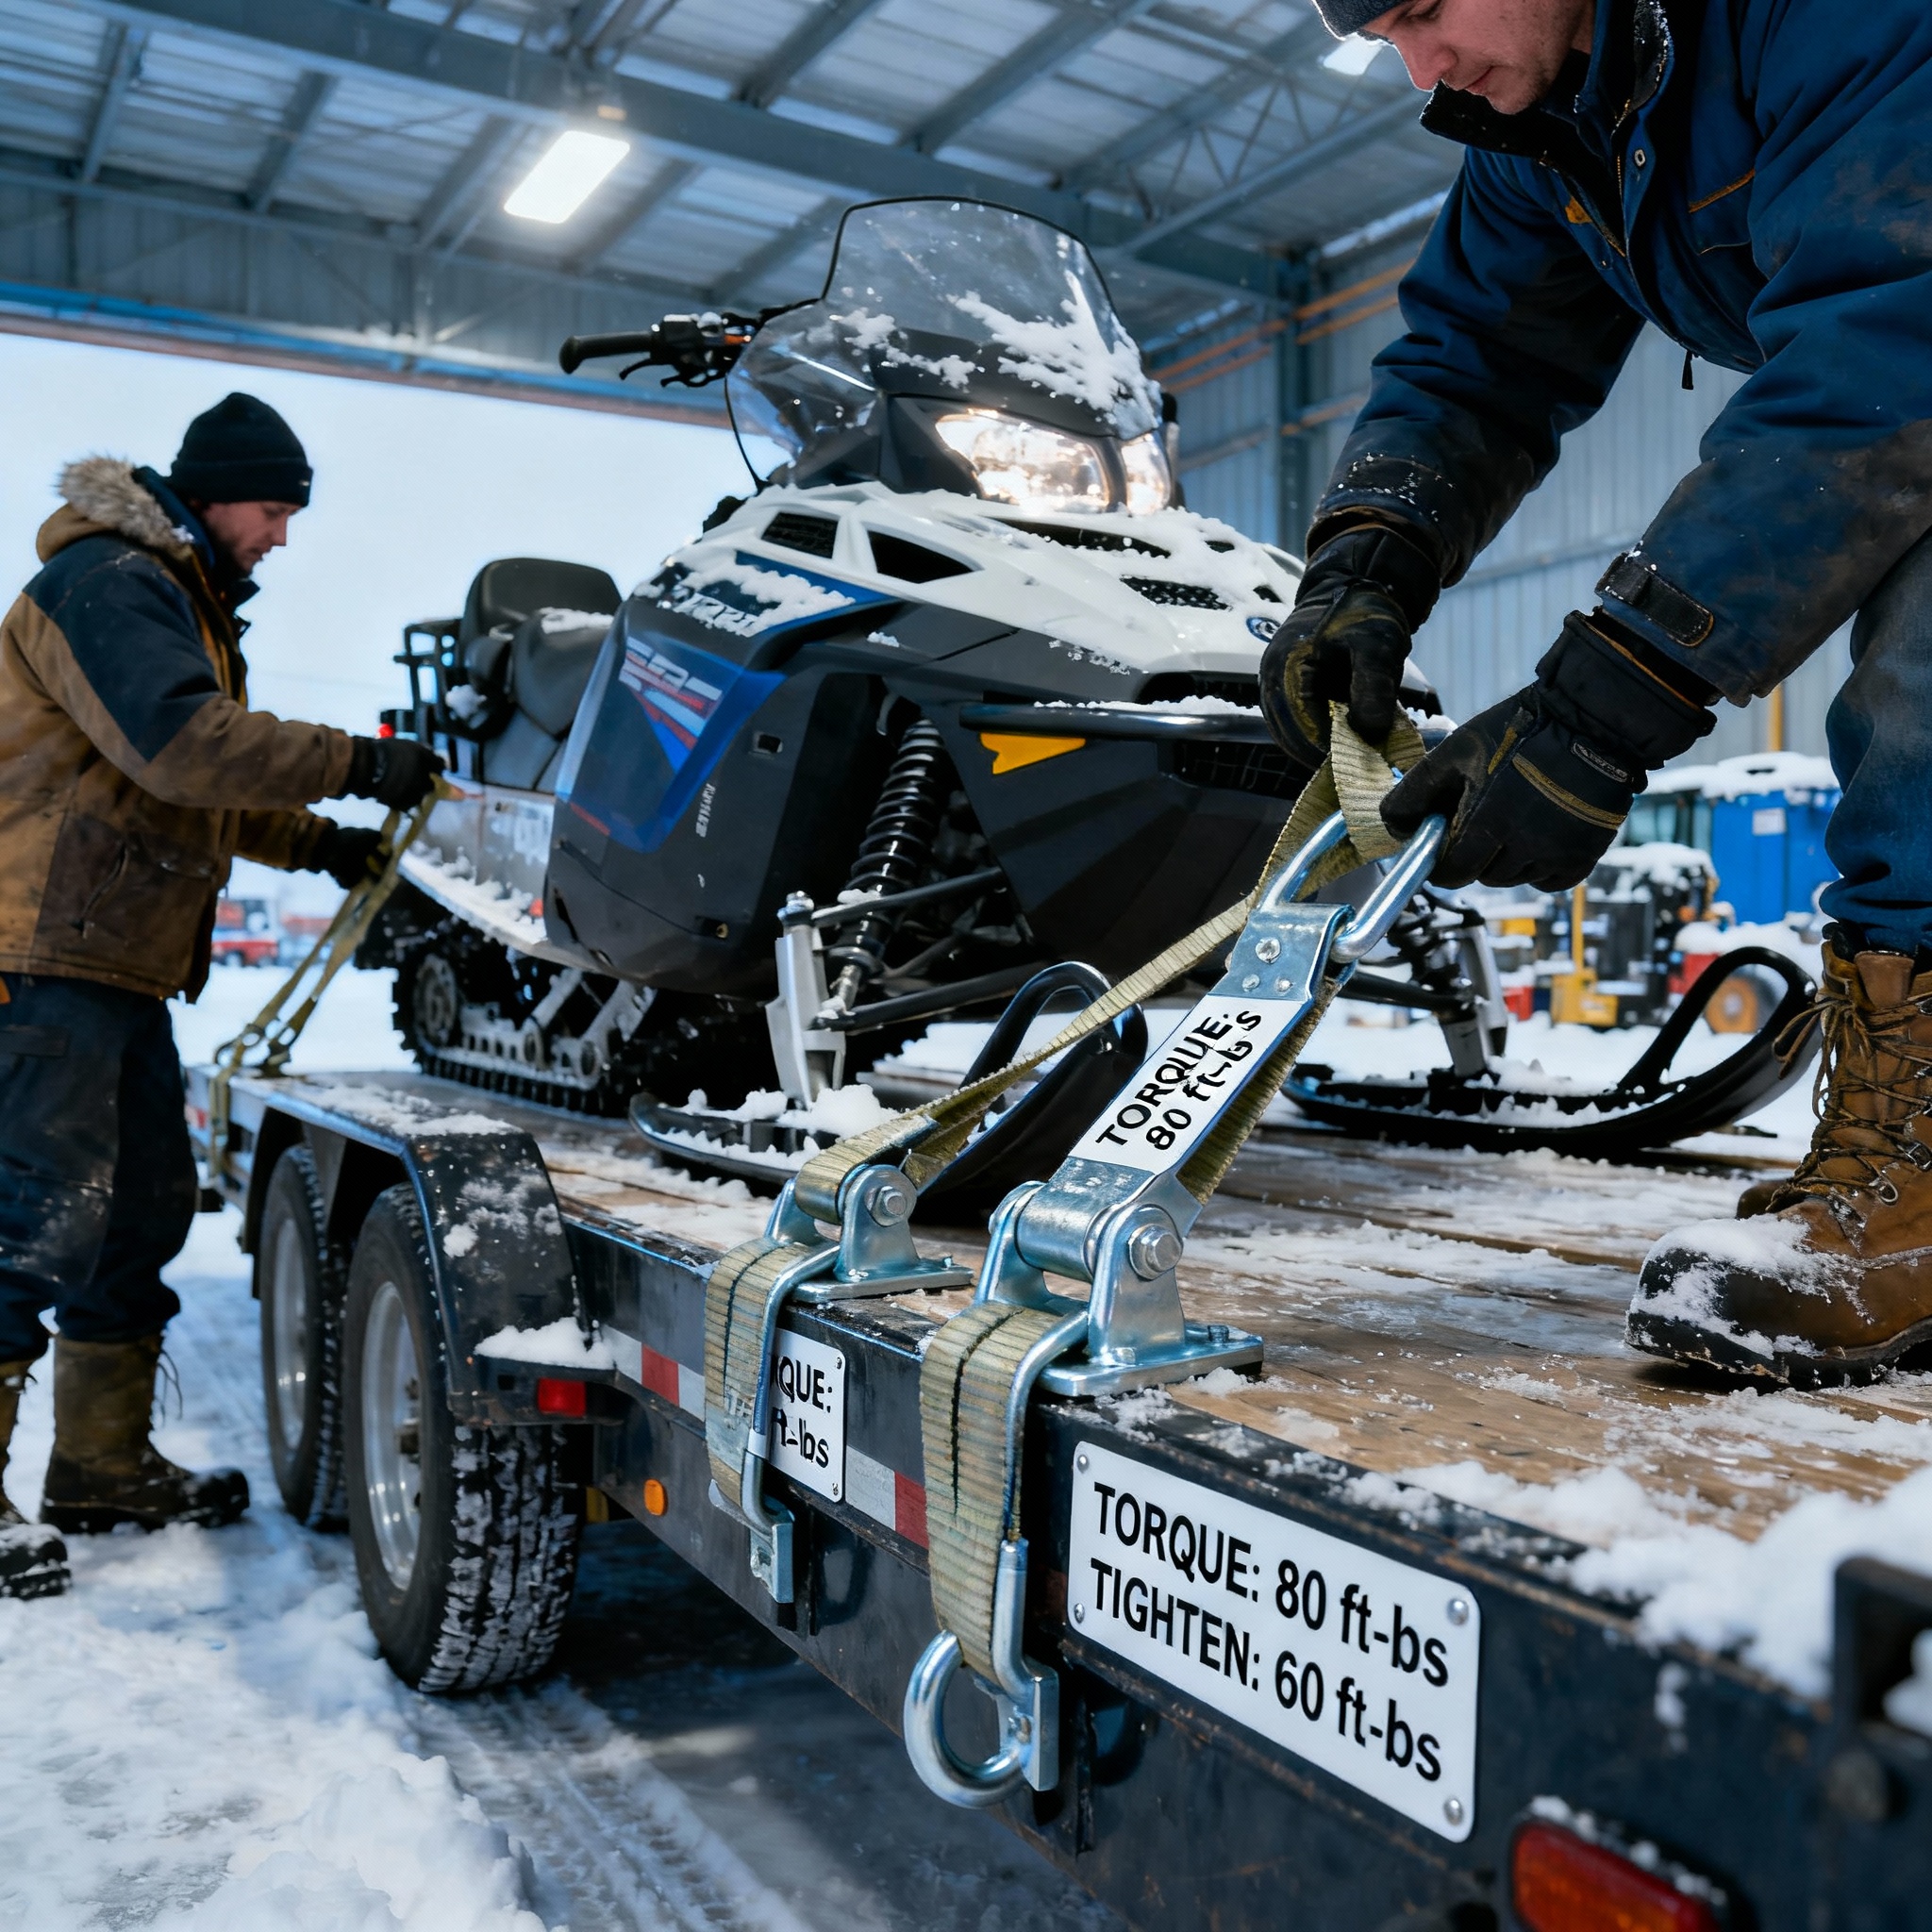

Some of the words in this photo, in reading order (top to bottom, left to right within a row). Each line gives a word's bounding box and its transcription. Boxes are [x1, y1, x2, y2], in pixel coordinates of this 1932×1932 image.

[1146, 1108, 1191, 1150] 80
[774, 1356, 832, 1413] QUE:
[1094, 1482, 1259, 1603] TORQUE:
[1275, 1559, 1326, 1630] 80
[1341, 1584, 1448, 1687] ft-bs
[1091, 1557, 1259, 1691] TIGHTEN:
[1274, 1651, 1324, 1722] 60
[1336, 1677, 1441, 1782] ft-bs
